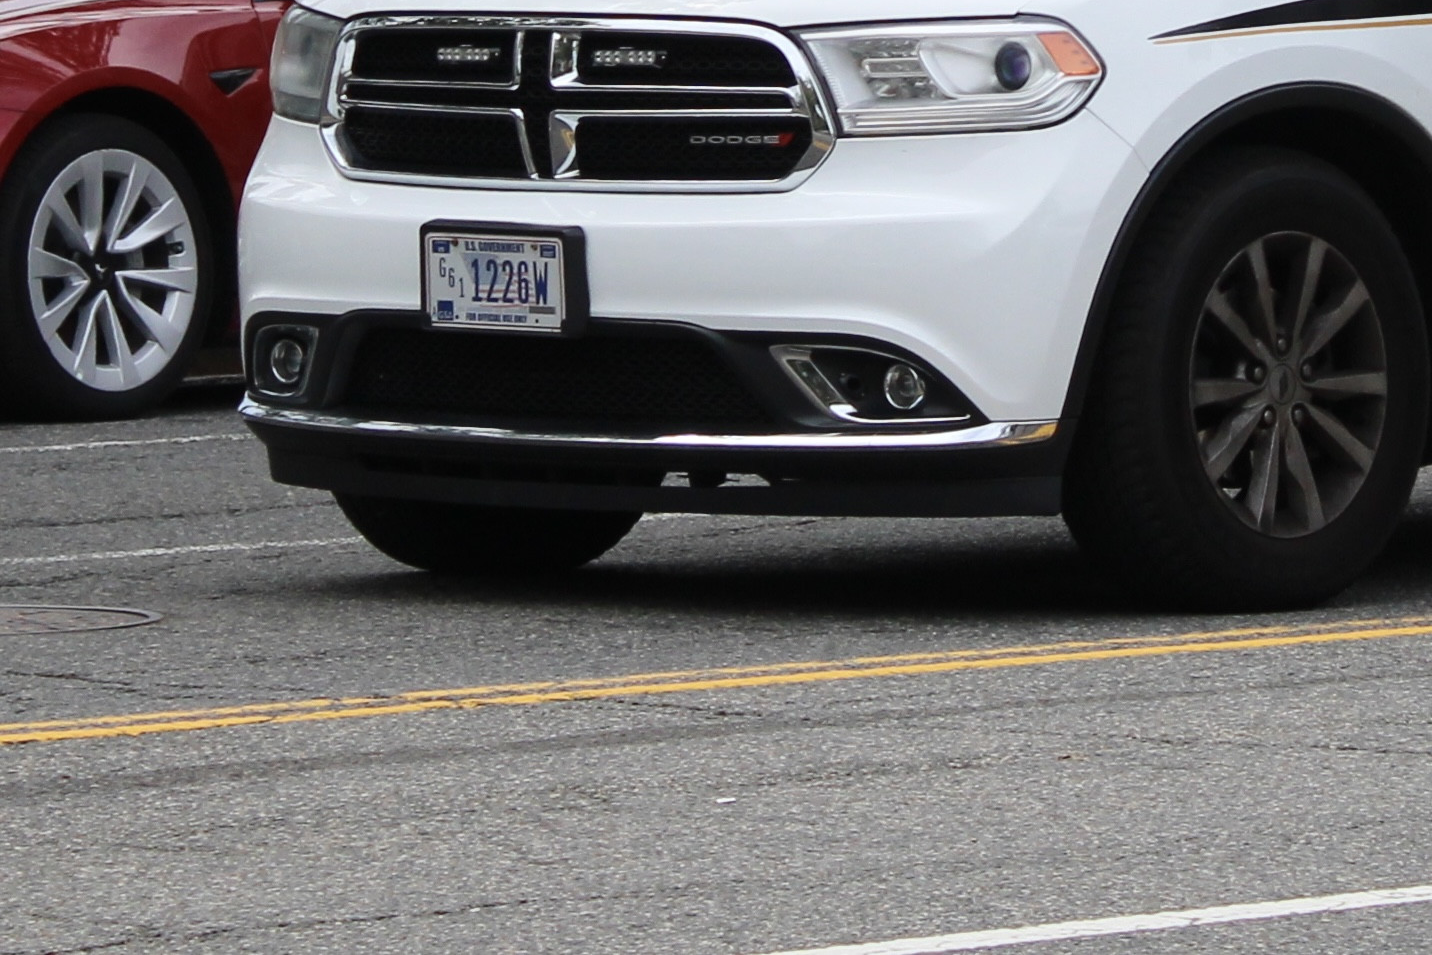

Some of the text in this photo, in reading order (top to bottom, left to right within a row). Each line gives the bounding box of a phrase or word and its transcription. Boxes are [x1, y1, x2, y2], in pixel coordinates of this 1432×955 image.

[689, 135, 780, 144] DODGE
[465, 241, 525, 254] U.S. GOVERNMENT
[471, 259, 549, 305] 1226W
